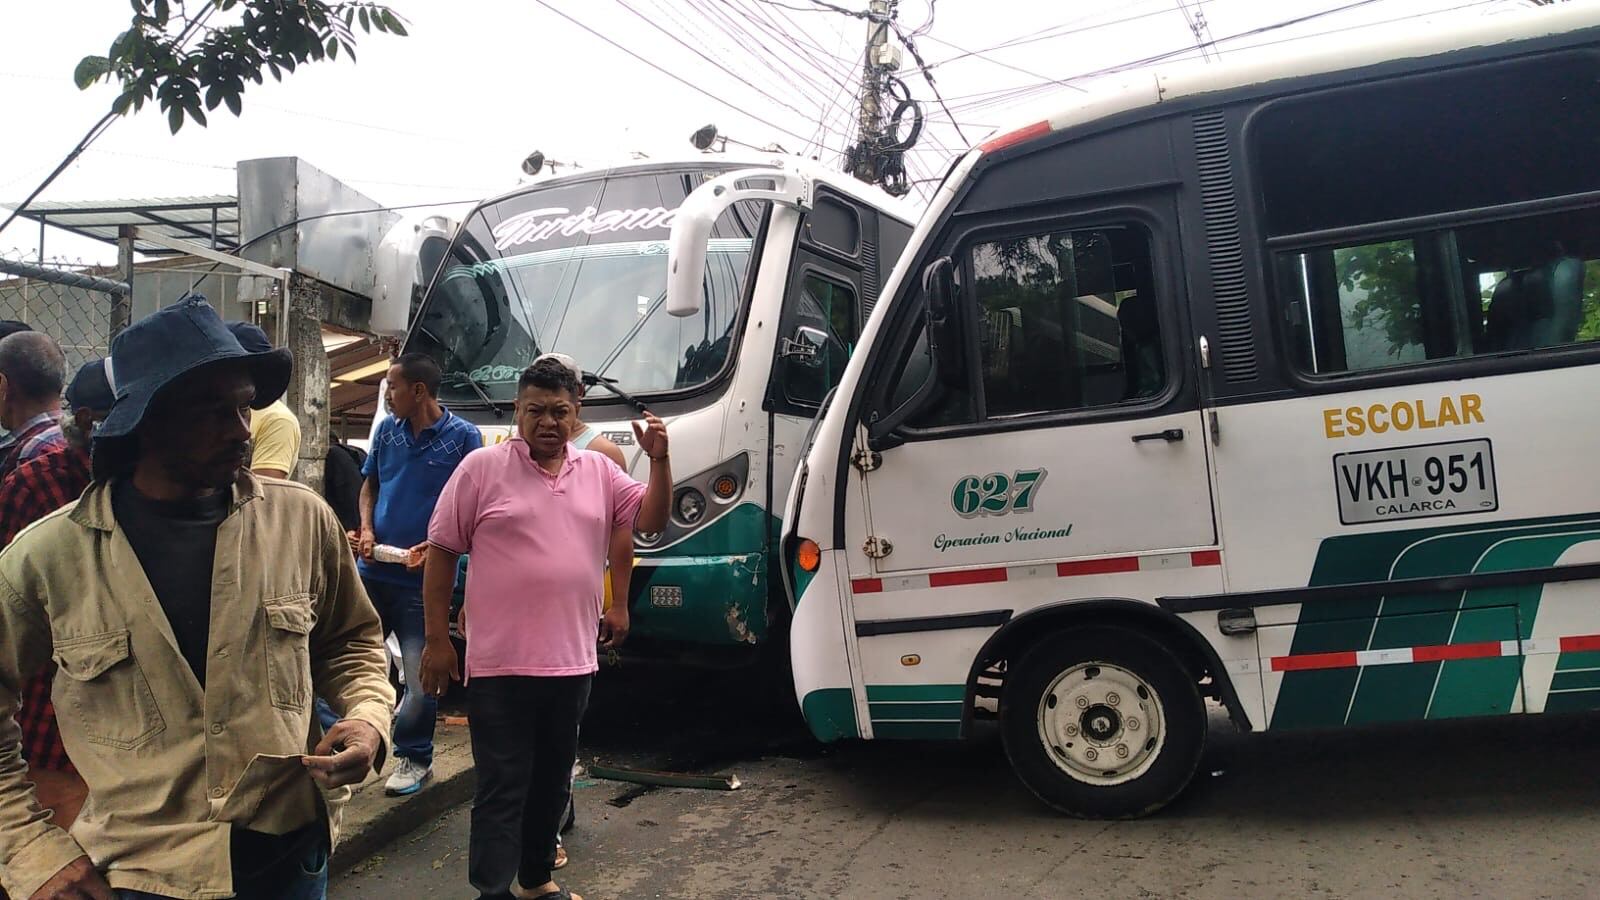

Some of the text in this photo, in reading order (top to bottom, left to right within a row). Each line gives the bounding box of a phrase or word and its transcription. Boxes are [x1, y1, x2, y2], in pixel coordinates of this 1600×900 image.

[1323, 393, 1486, 439] ESCOLAR
[951, 467, 1048, 519] 627
[1341, 451, 1486, 503] VKH 951
[1375, 498, 1457, 516] CALARCA
[933, 523, 1073, 553] Operacion Nacional
